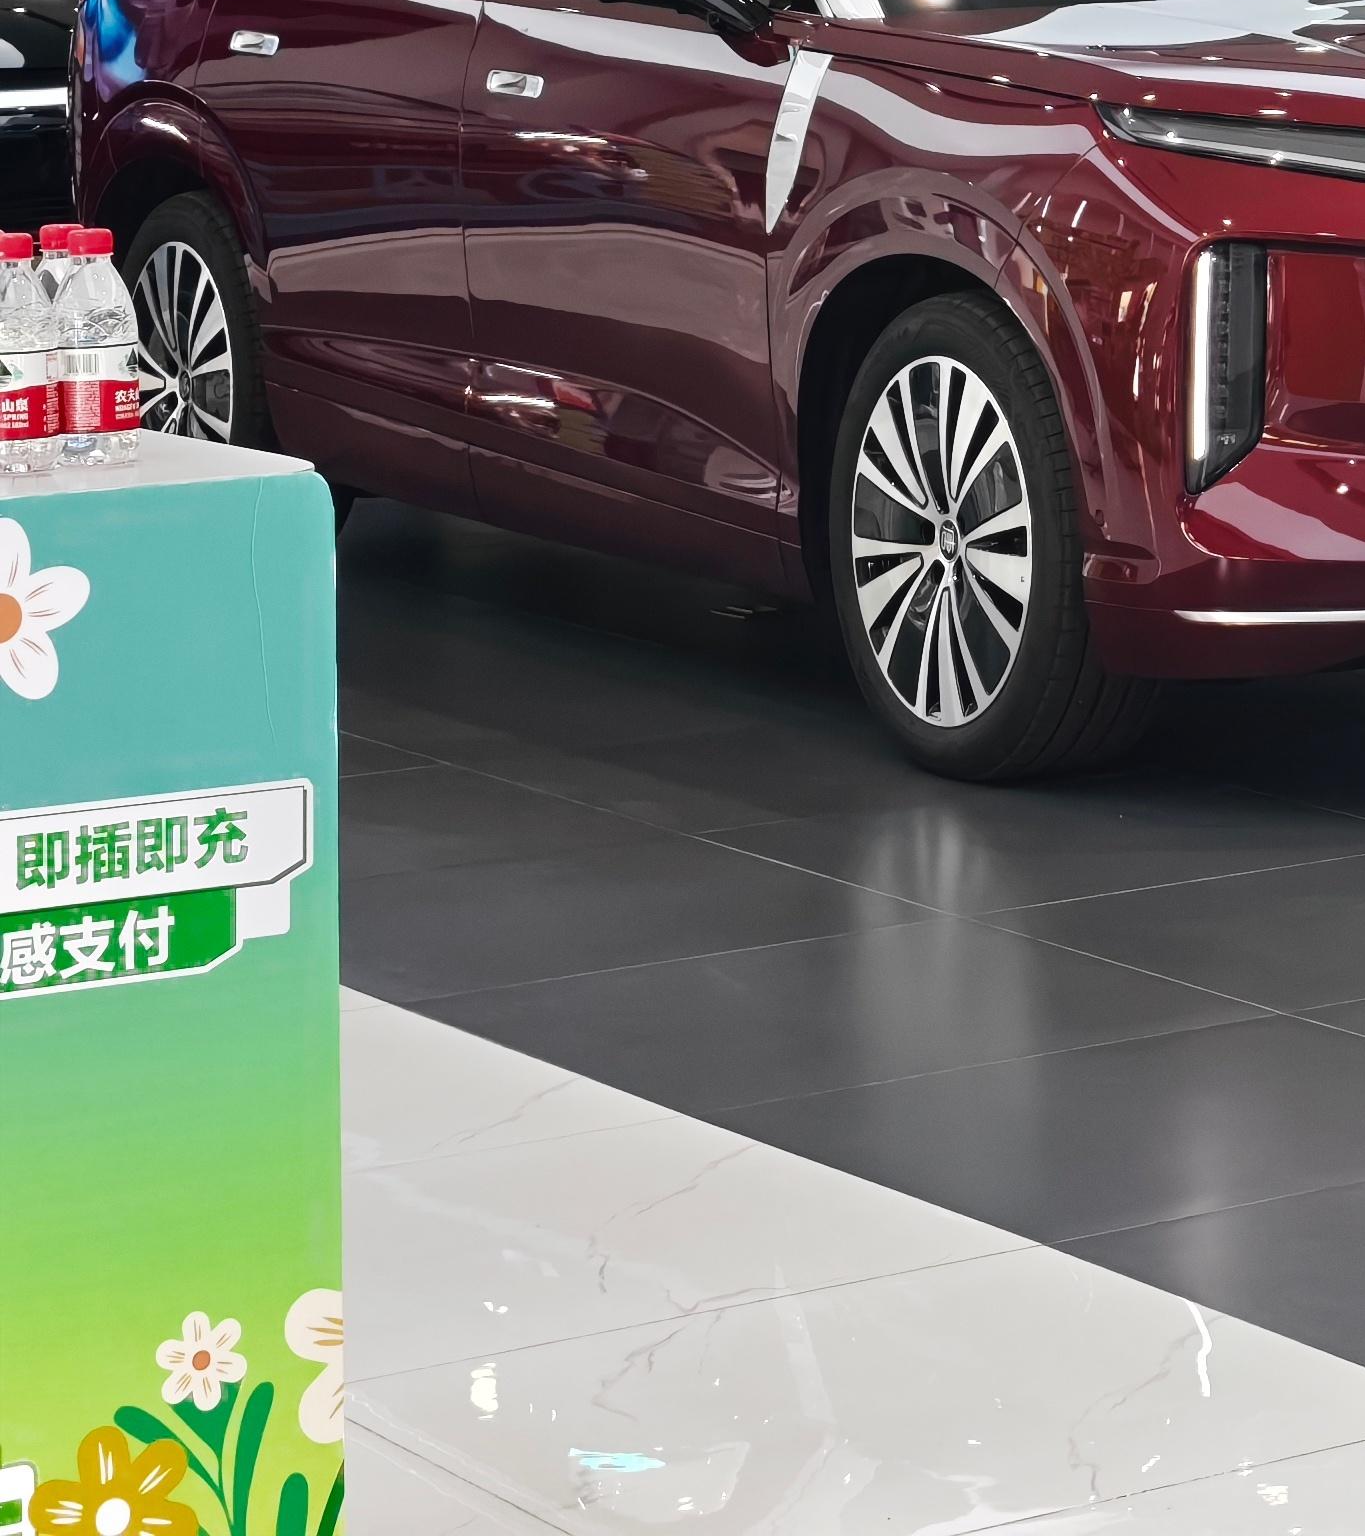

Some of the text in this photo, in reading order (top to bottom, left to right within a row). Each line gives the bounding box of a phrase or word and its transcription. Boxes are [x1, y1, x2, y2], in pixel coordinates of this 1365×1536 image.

[15, 807, 250, 891] 即插即充
[0, 905, 175, 985] 感支付
